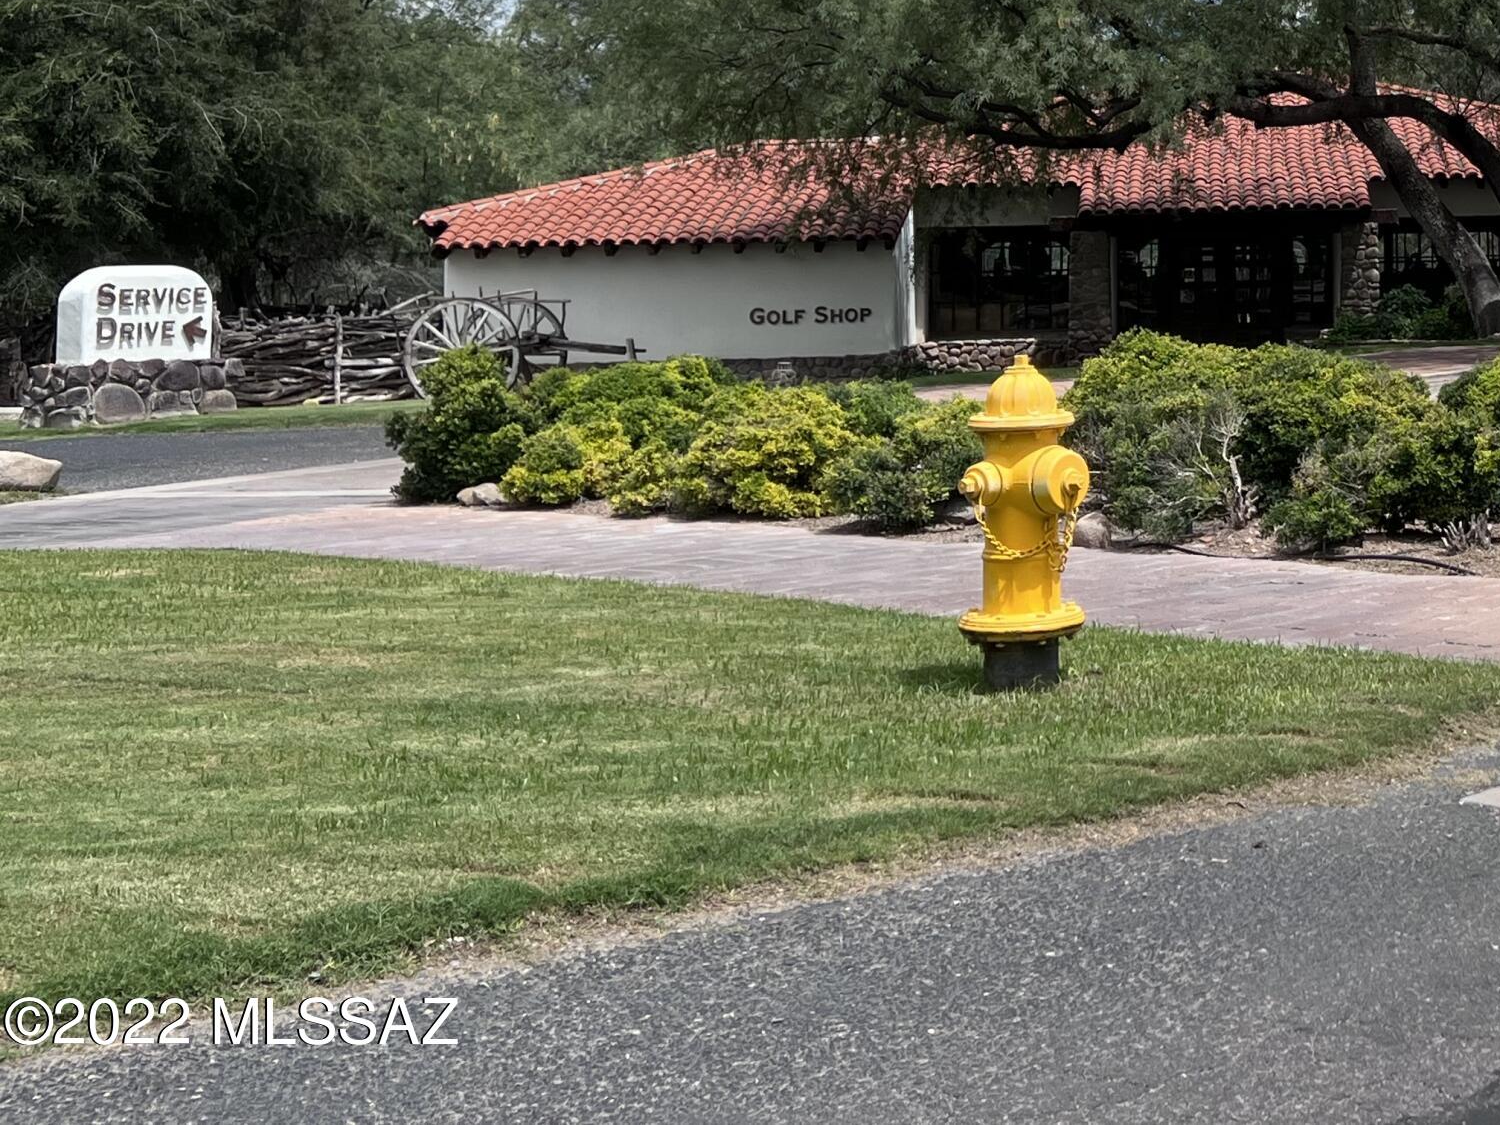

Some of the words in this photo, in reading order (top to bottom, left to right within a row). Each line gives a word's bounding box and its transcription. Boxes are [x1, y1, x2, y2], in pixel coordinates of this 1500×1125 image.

[97, 283, 207, 309] SERVICE
[749, 307, 806, 325] GOLF
[814, 306, 873, 324] SHOP
[96, 317, 176, 344] DRIVE
